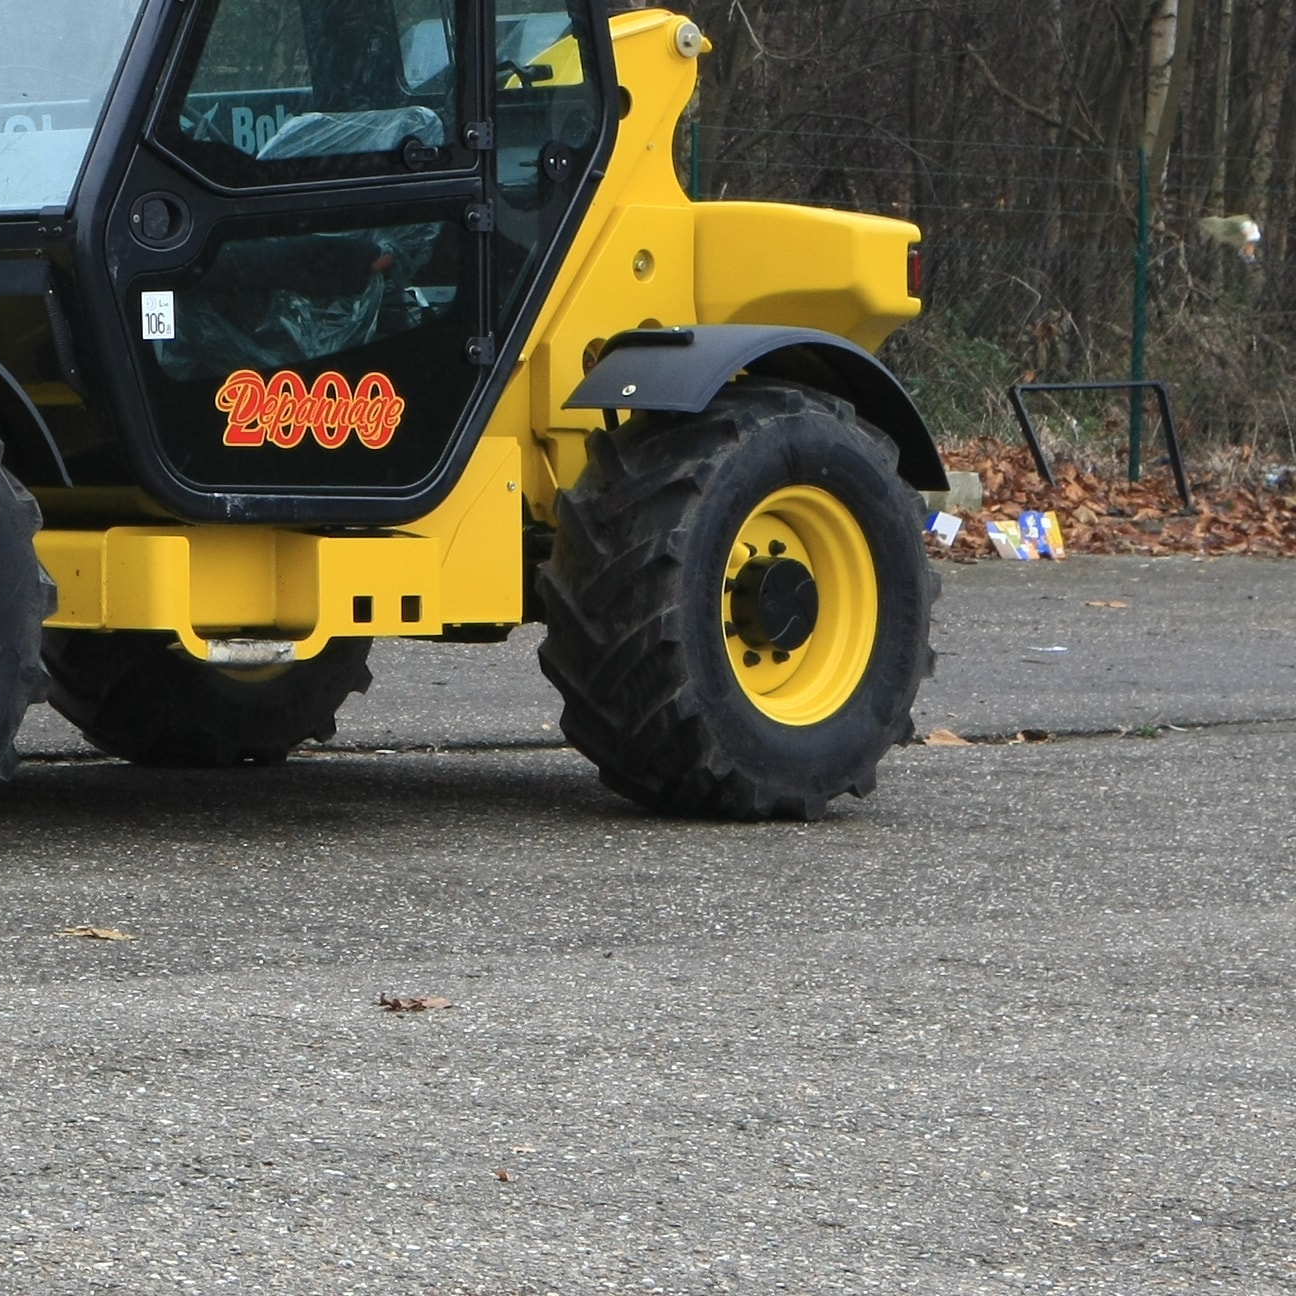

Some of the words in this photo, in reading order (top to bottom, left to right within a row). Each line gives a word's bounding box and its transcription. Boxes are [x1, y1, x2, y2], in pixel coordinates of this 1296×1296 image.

[144, 312, 166, 335] 106
[215, 376, 406, 442] Depannage
[223, 370, 397, 449] 2000
